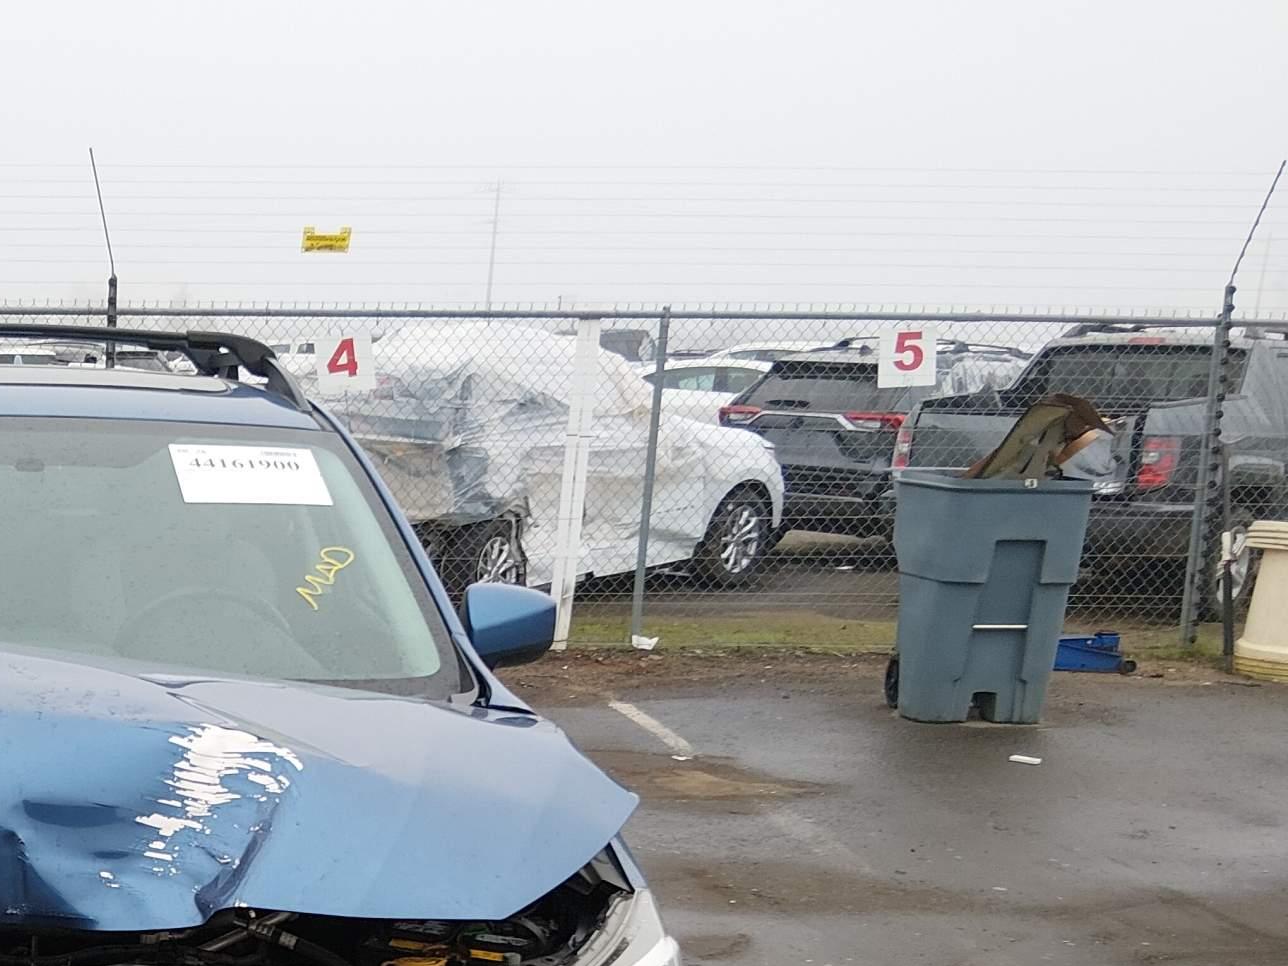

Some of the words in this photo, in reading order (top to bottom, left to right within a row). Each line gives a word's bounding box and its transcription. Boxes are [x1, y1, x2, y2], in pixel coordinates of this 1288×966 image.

[327, 337, 358, 377] 4
[893, 331, 924, 371] 5
[188, 457, 301, 471] 44161900
